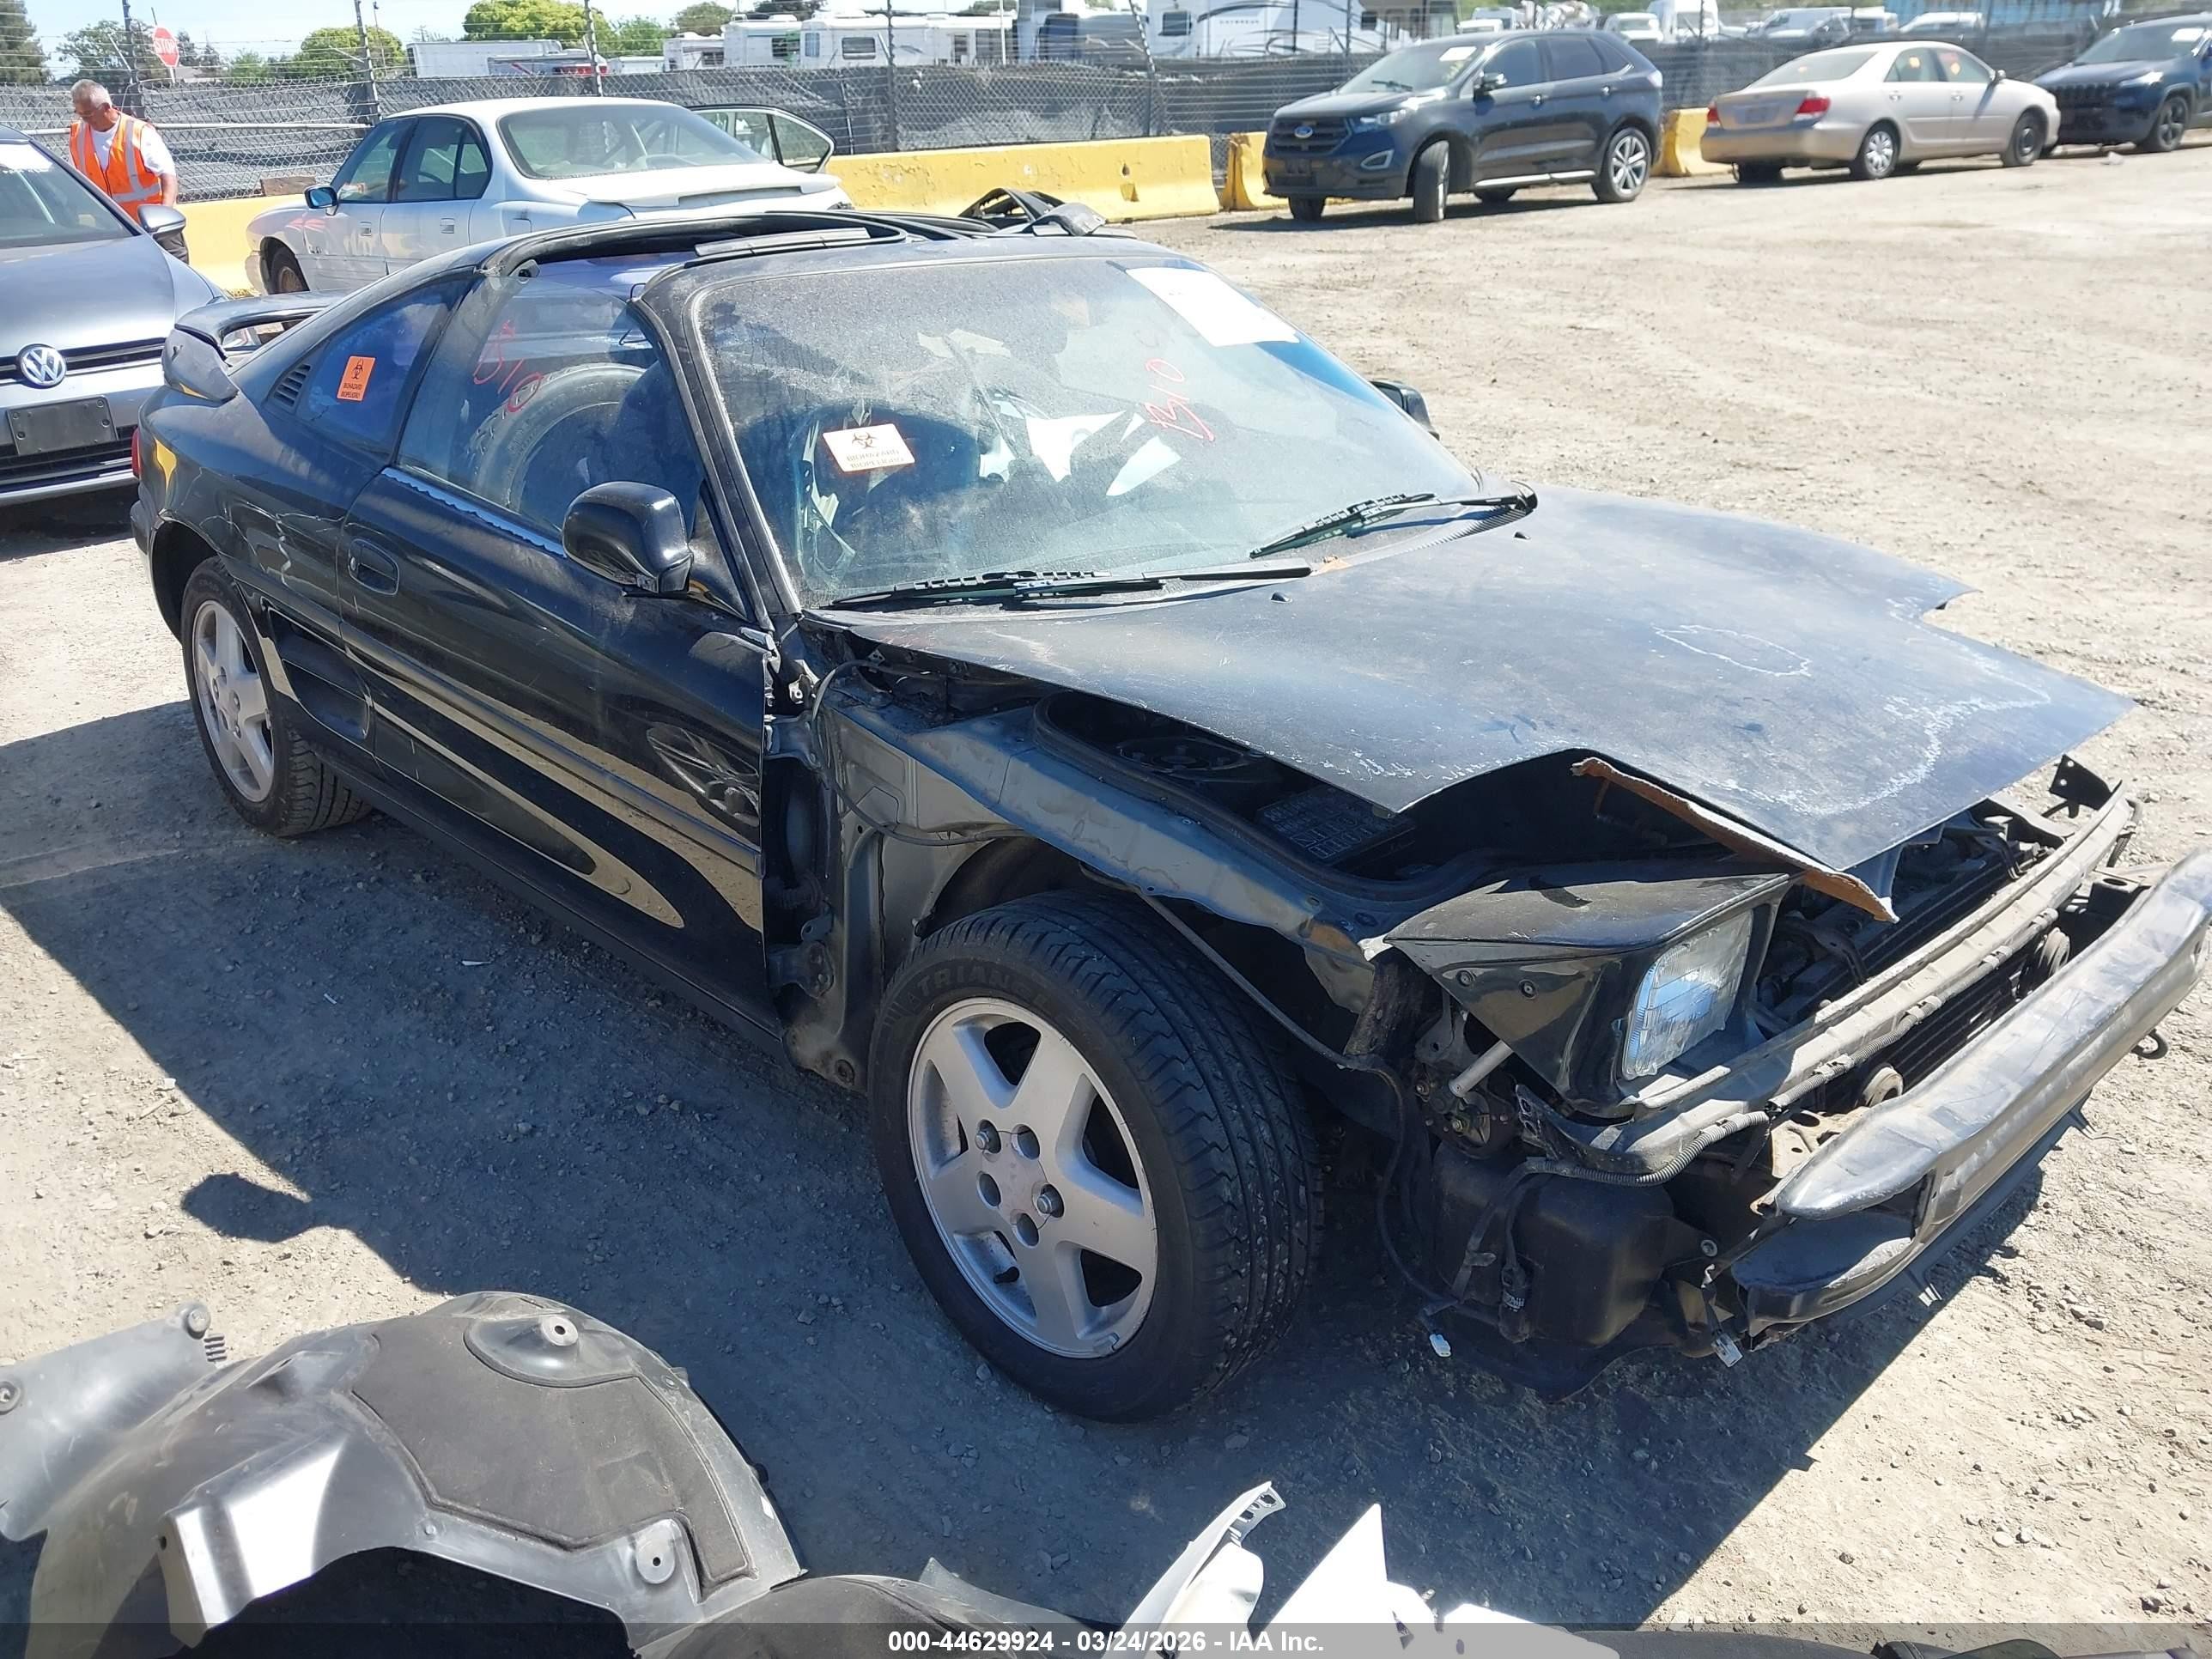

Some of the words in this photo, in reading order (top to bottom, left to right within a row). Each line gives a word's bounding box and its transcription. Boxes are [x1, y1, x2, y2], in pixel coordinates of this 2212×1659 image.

[154, 38, 177, 54] STOP
[343, 382, 362, 391] BIOHAZARD
[1144, 357, 1215, 442] BIO
